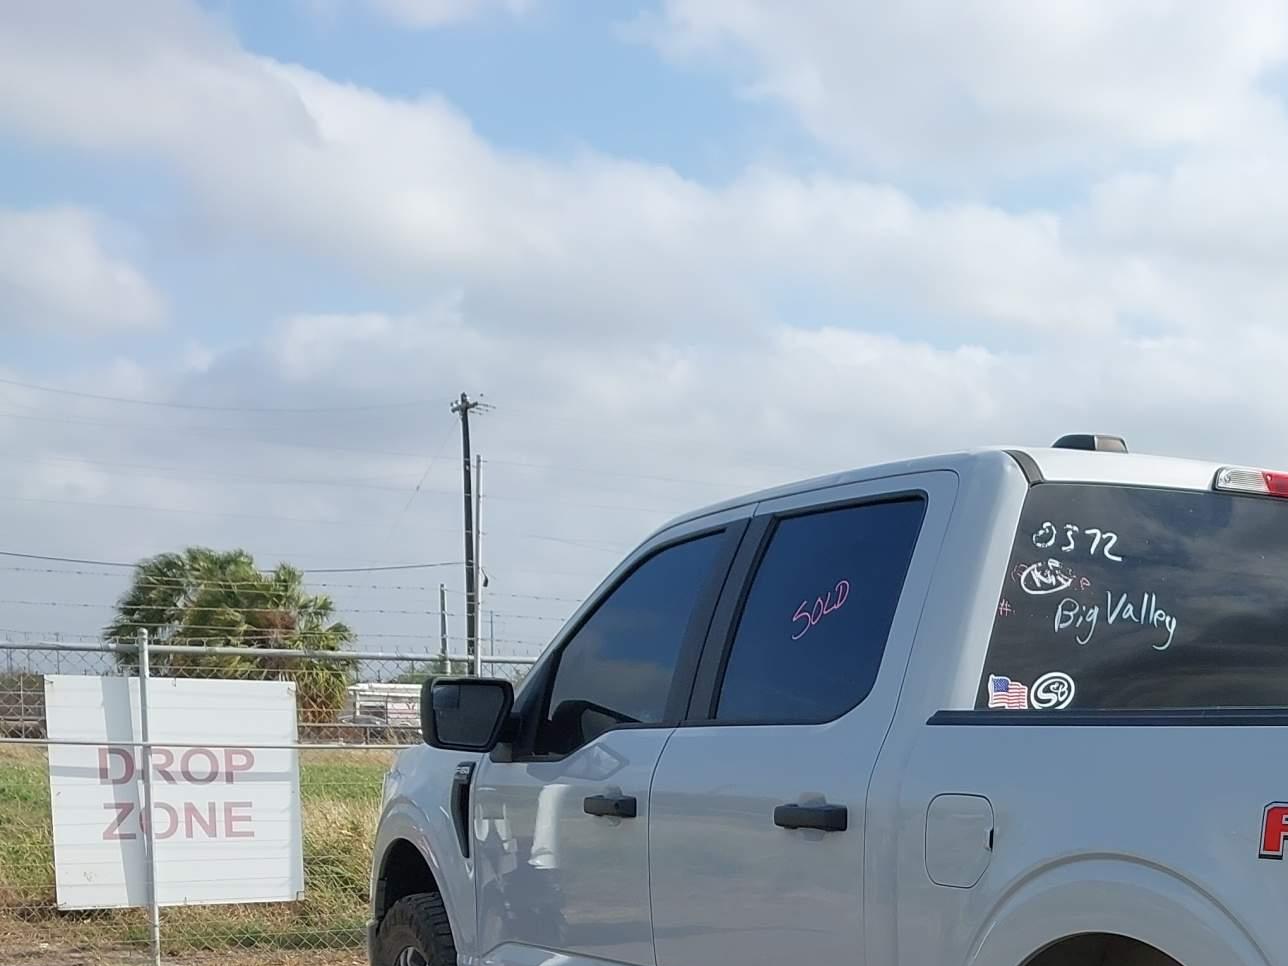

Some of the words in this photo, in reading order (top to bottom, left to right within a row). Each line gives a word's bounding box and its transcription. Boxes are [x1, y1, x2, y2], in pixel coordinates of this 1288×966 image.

[791, 580, 850, 640] SOLD
[1054, 598, 1099, 645] Big
[1106, 590, 1177, 650] Valley
[98, 747, 256, 785] DROP
[102, 801, 256, 841] ZONE
